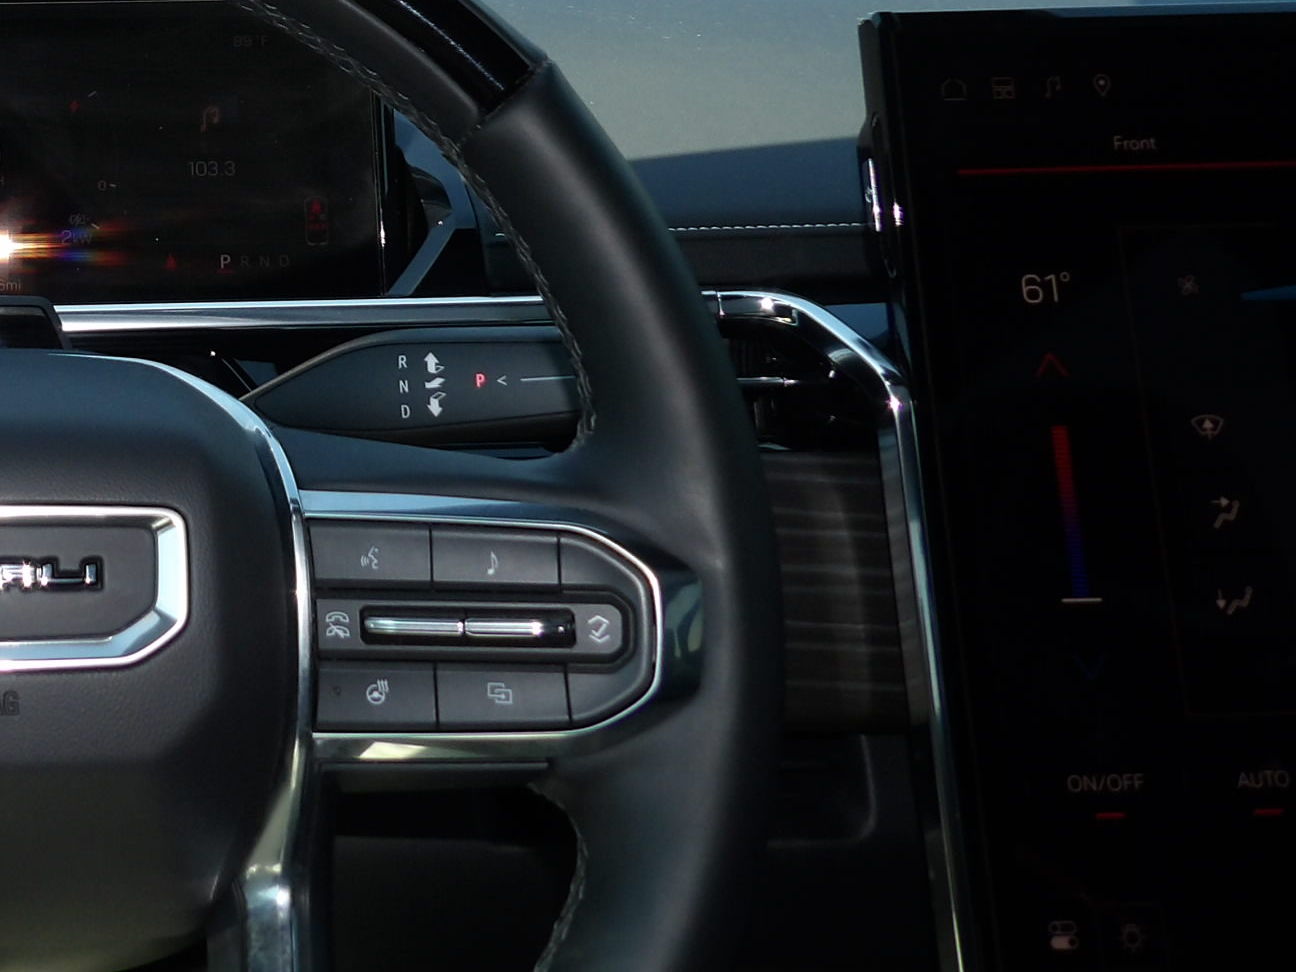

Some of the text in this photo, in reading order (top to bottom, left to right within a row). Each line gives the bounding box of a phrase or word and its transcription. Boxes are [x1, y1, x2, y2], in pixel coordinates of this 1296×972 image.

[1112, 134, 1159, 152] Front
[187, 160, 237, 178] 103.3
[398, 355, 407, 369] R
[399, 380, 409, 393] N
[475, 373, 485, 387] P
[401, 405, 410, 418] D
[1066, 772, 1145, 794] ON/OFF
[1236, 769, 1291, 790] AUTO
